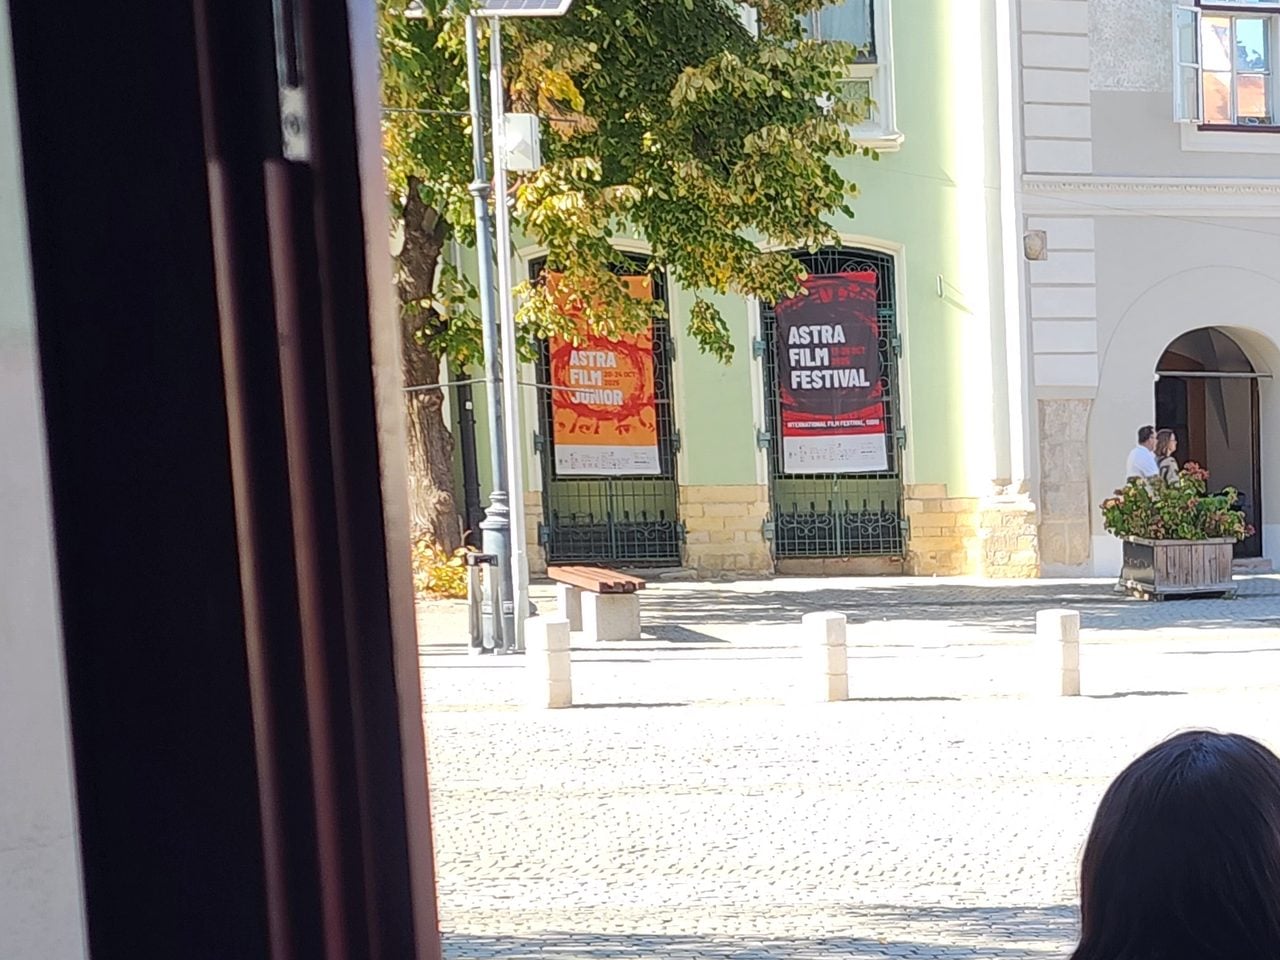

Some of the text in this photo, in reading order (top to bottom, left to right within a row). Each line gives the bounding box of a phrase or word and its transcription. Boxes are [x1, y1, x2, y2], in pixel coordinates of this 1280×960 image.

[788, 324, 846, 345] ASTRA
[569, 350, 617, 368] ASTRA
[788, 347, 830, 367] FILM
[569, 369, 602, 386] FILM
[790, 368, 871, 389] FESTIVAL
[571, 388, 624, 406] JUNIOR
